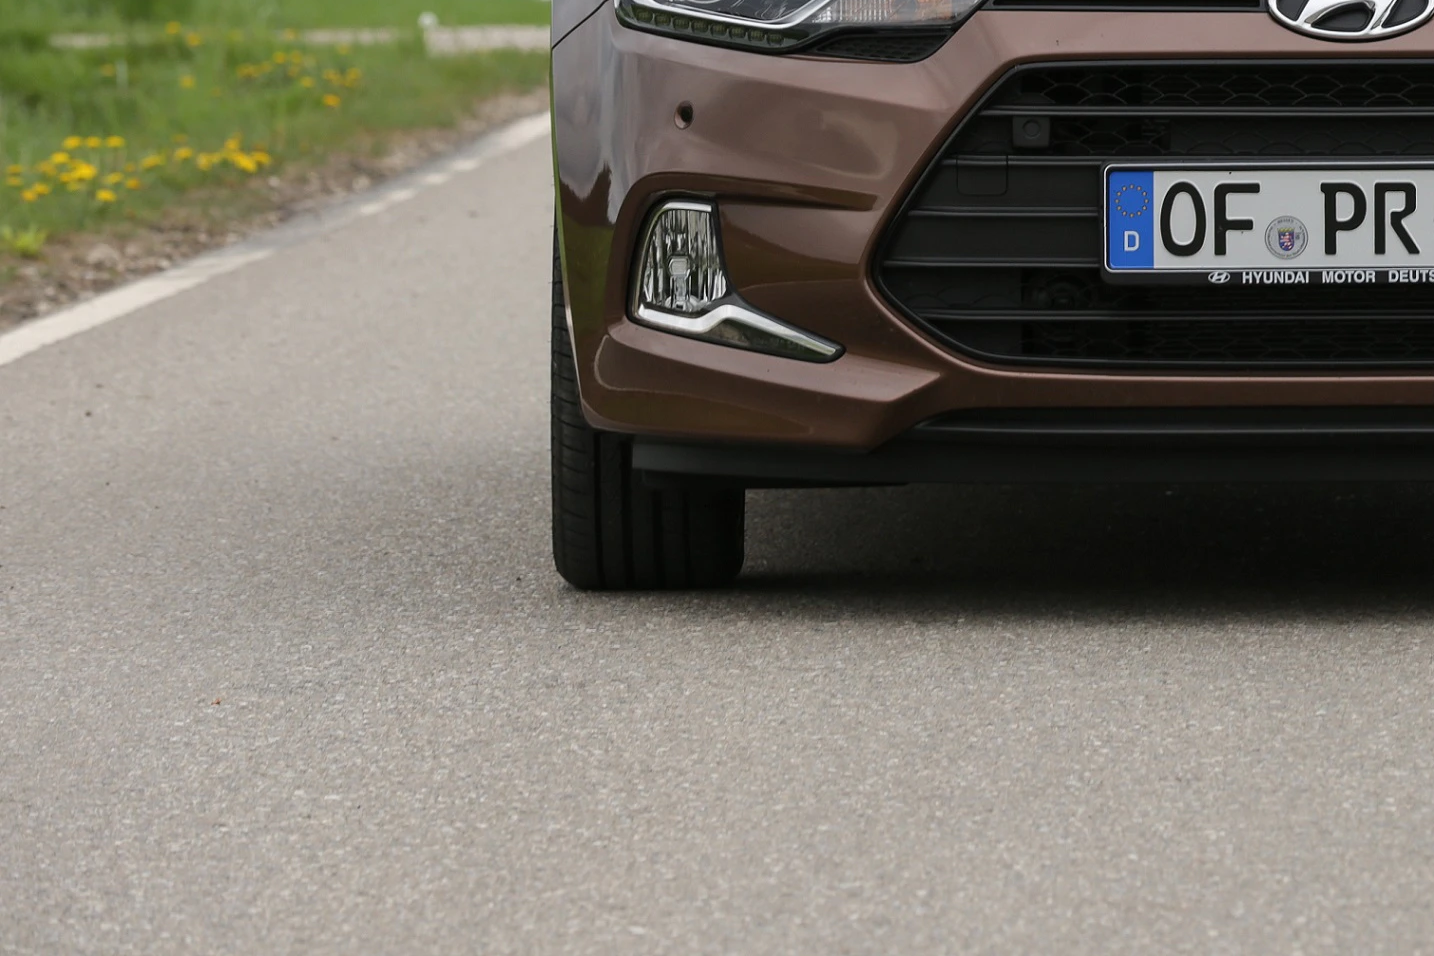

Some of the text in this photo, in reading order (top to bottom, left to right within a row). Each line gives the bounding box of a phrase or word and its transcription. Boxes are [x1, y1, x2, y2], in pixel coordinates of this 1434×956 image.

[1159, 181, 1261, 257] OF
[1320, 181, 1421, 256] PR
[1123, 230, 1140, 252] D
[1242, 270, 1310, 284] HYUNDAI
[1321, 269, 1376, 284] MOTOR
